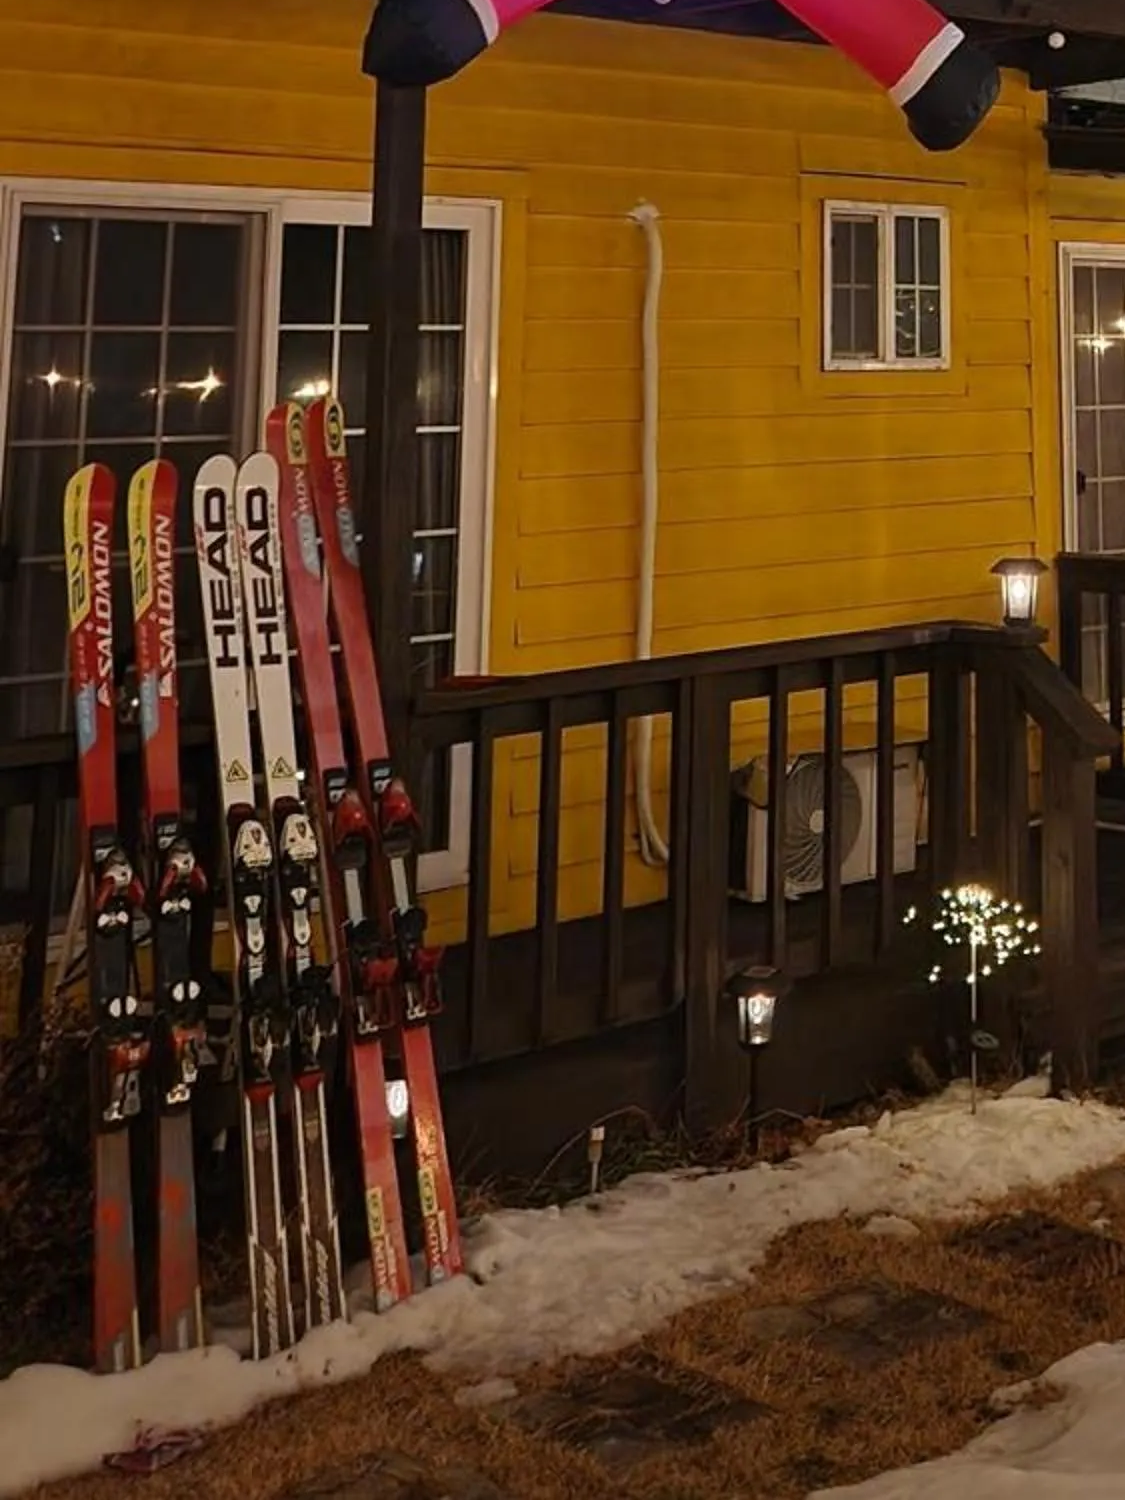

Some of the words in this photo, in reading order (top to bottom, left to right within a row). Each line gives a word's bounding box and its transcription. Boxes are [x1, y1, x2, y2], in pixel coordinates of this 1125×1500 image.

[92, 520, 114, 680] SALOMON
[154, 513, 178, 674] SALOMON
[203, 486, 240, 669] HEAD
[245, 486, 283, 666] HEAD
